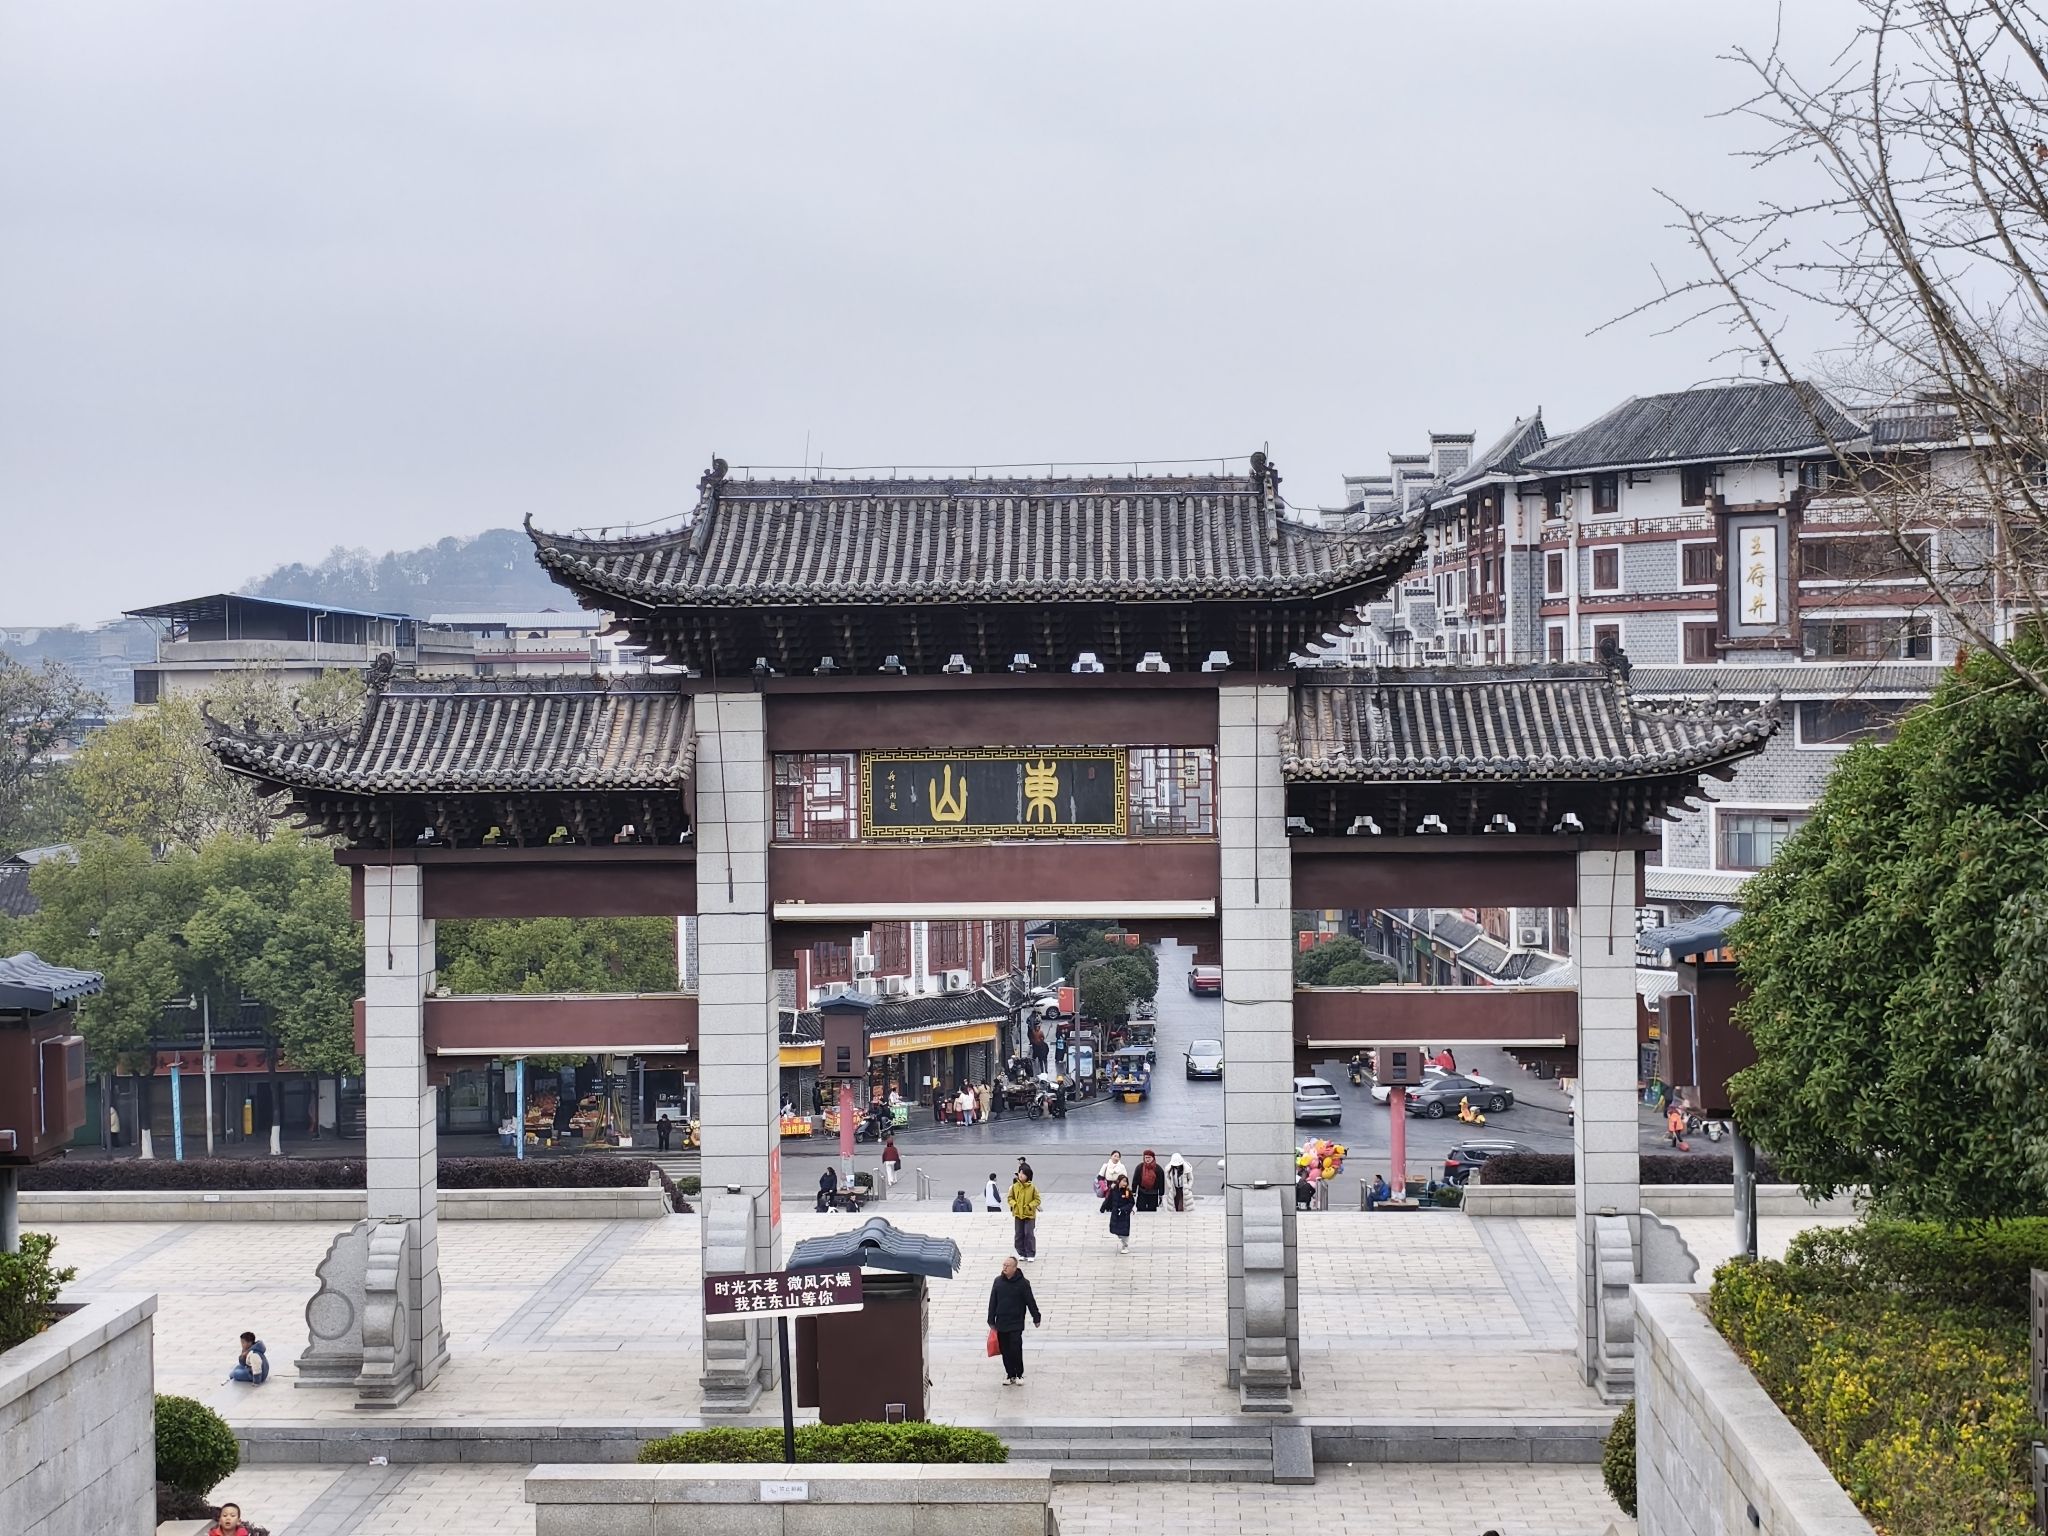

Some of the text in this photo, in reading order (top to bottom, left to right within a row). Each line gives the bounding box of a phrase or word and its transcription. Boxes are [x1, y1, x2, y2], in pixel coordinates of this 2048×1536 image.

[1746, 535, 1767, 619] 王府井
[714, 1272, 852, 1296] 时光不老 微风不燥
[734, 1290, 834, 1312] 我在东山等你
